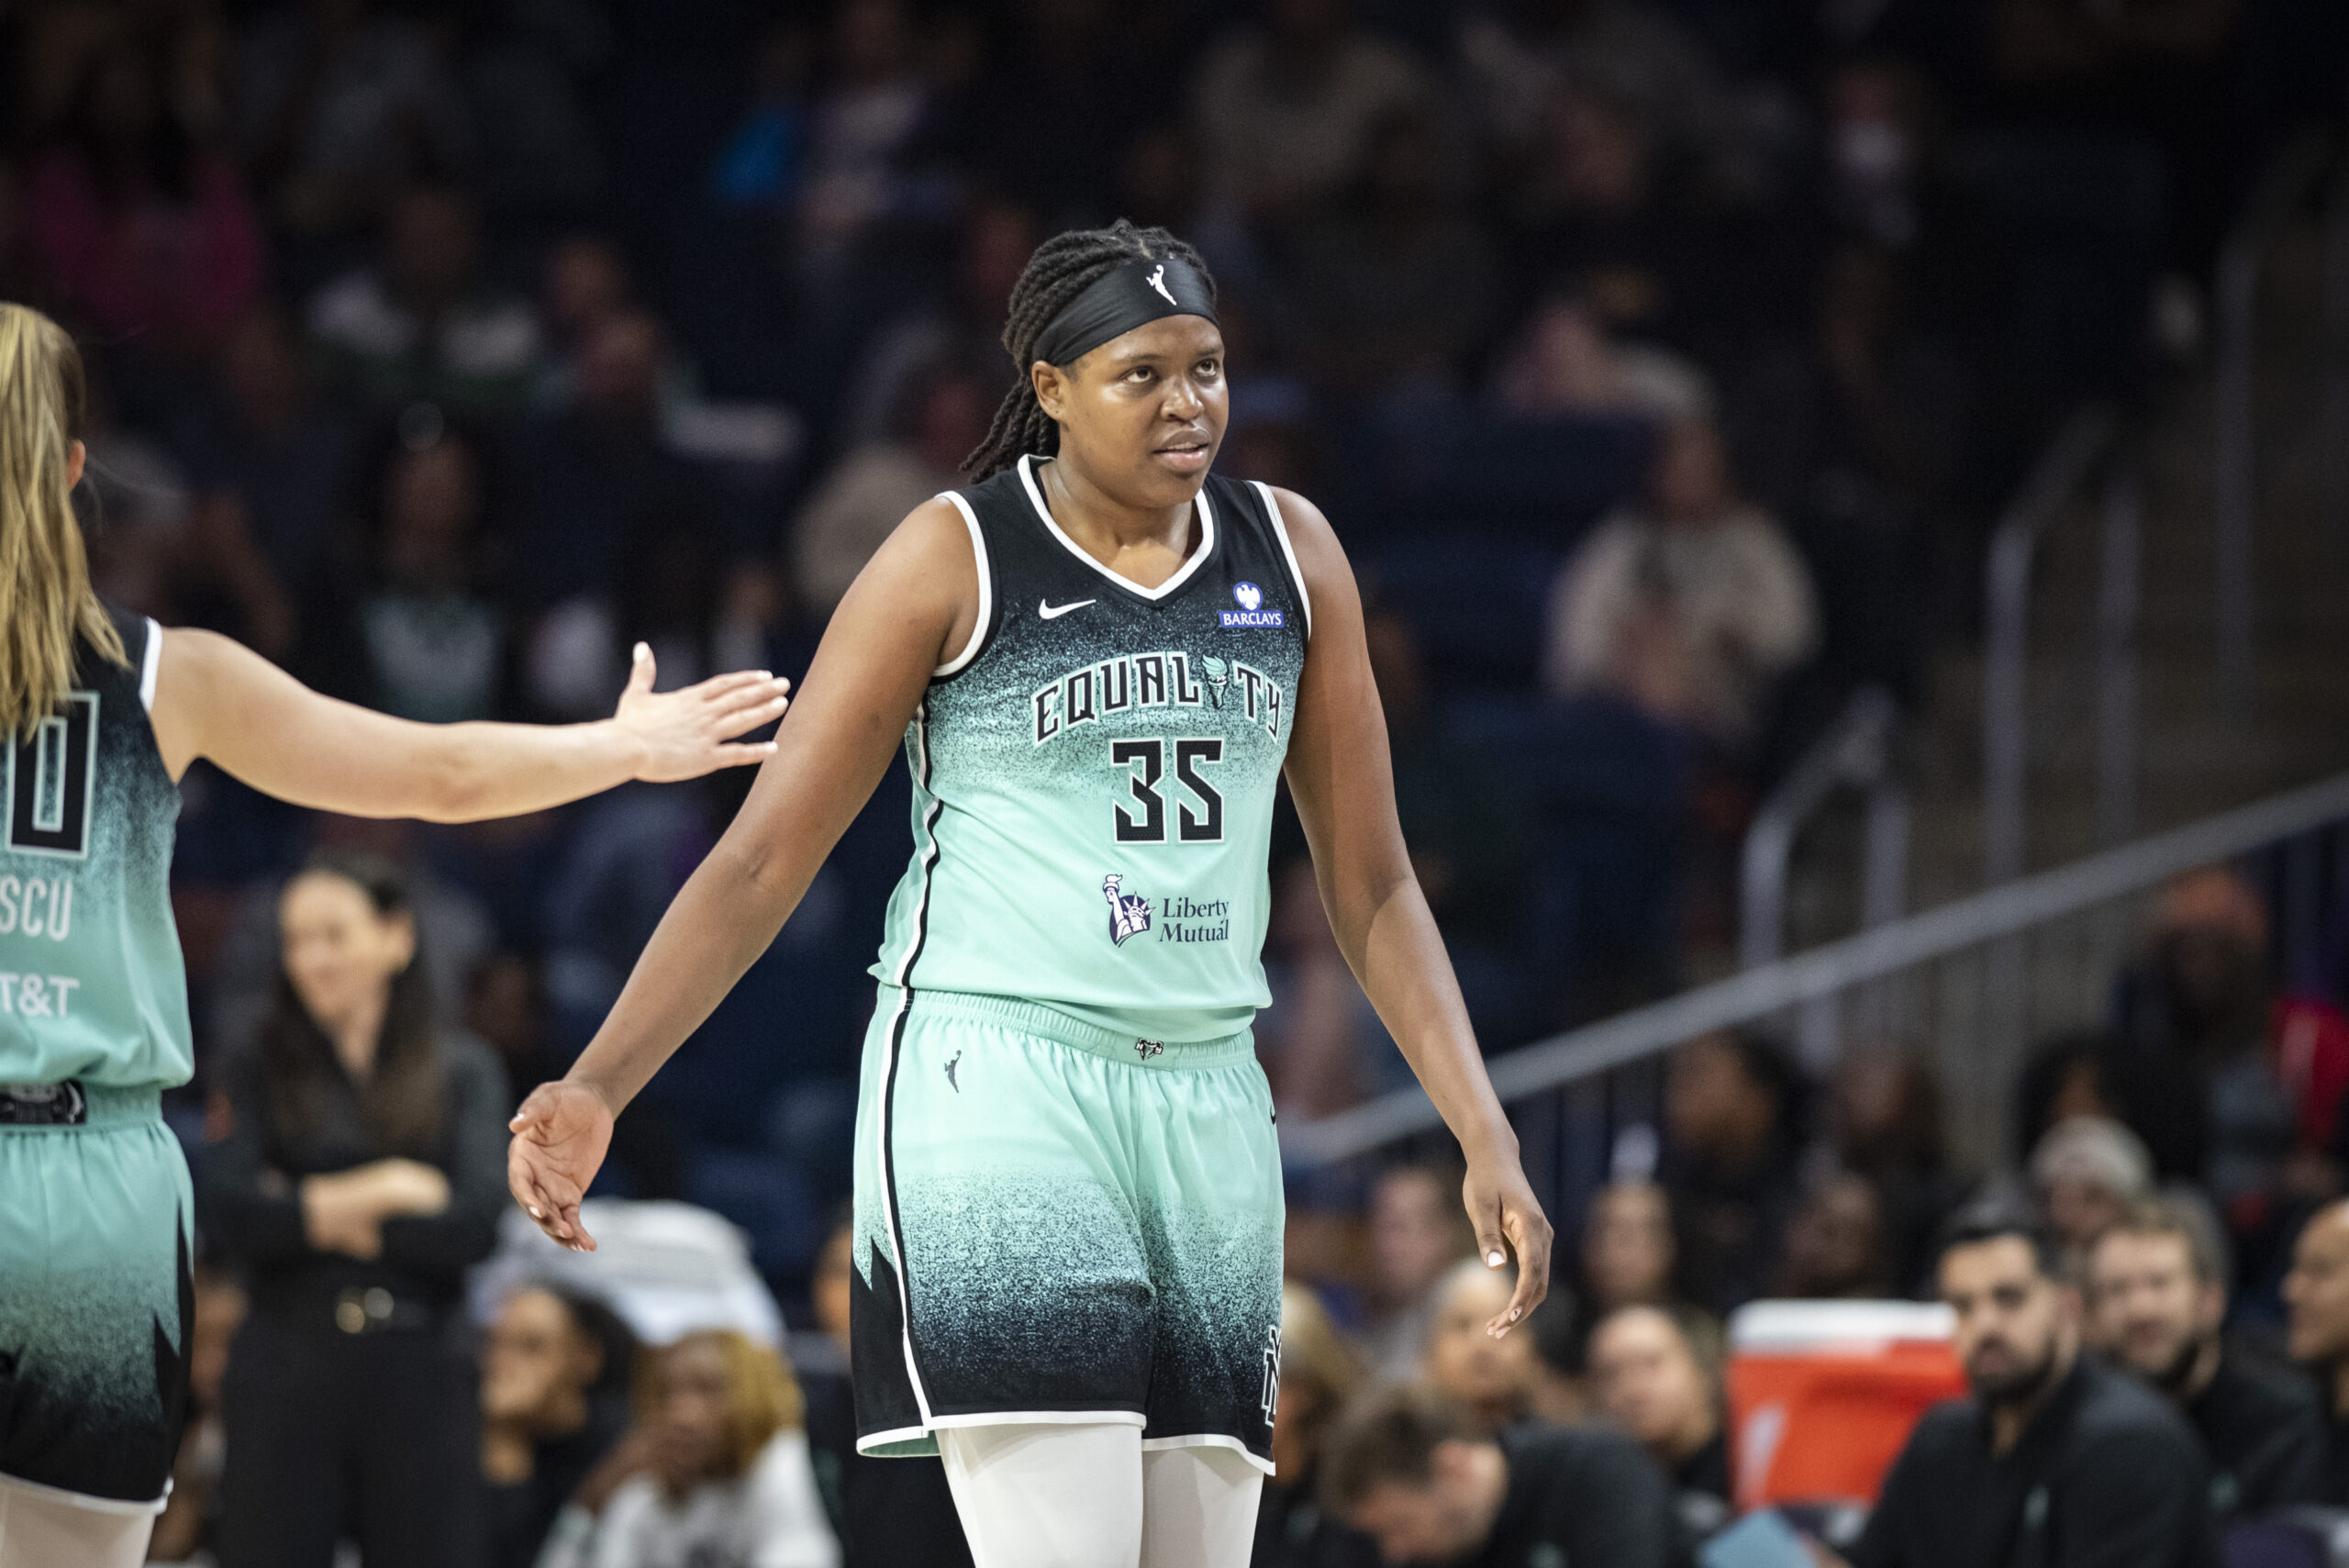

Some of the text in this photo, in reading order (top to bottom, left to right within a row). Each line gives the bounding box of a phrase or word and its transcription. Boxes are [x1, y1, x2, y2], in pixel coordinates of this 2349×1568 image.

[1222, 612, 1282, 626] BARCLAYS
[1110, 738, 1224, 844] 35
[1163, 896, 1230, 925] Liberty
[1159, 918, 1229, 943] Mutual
